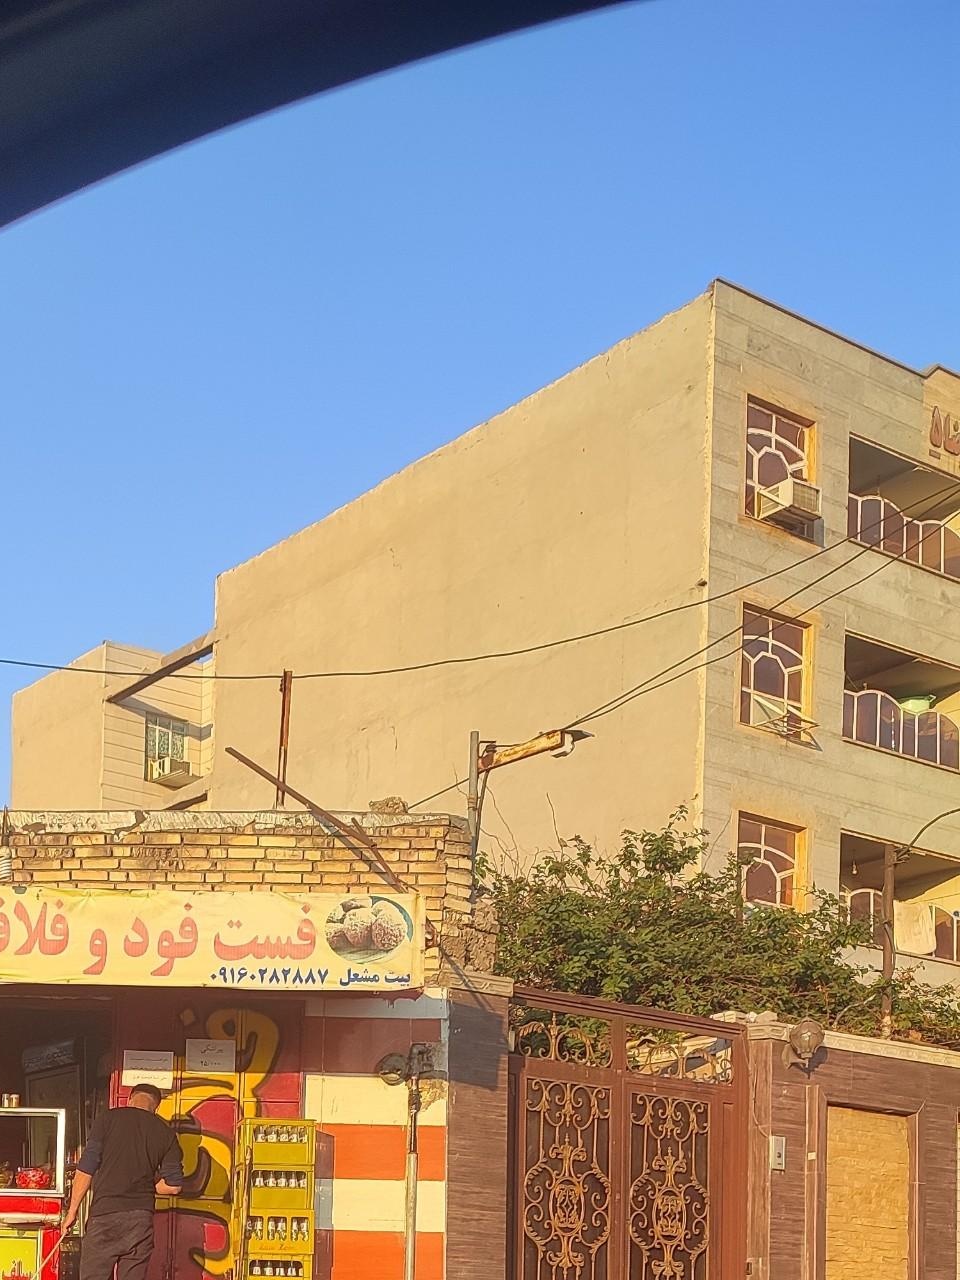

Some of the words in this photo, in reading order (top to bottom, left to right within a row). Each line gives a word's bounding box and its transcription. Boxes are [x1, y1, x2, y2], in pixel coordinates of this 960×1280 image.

[83, 927, 108, 976] و
[123, 902, 199, 977] فود
[214, 903, 317, 961] فست
[209, 966, 329, 985] ۰۹۱۶۰۲۸۲۸۸۷
[339, 967, 380, 986] مشعل
